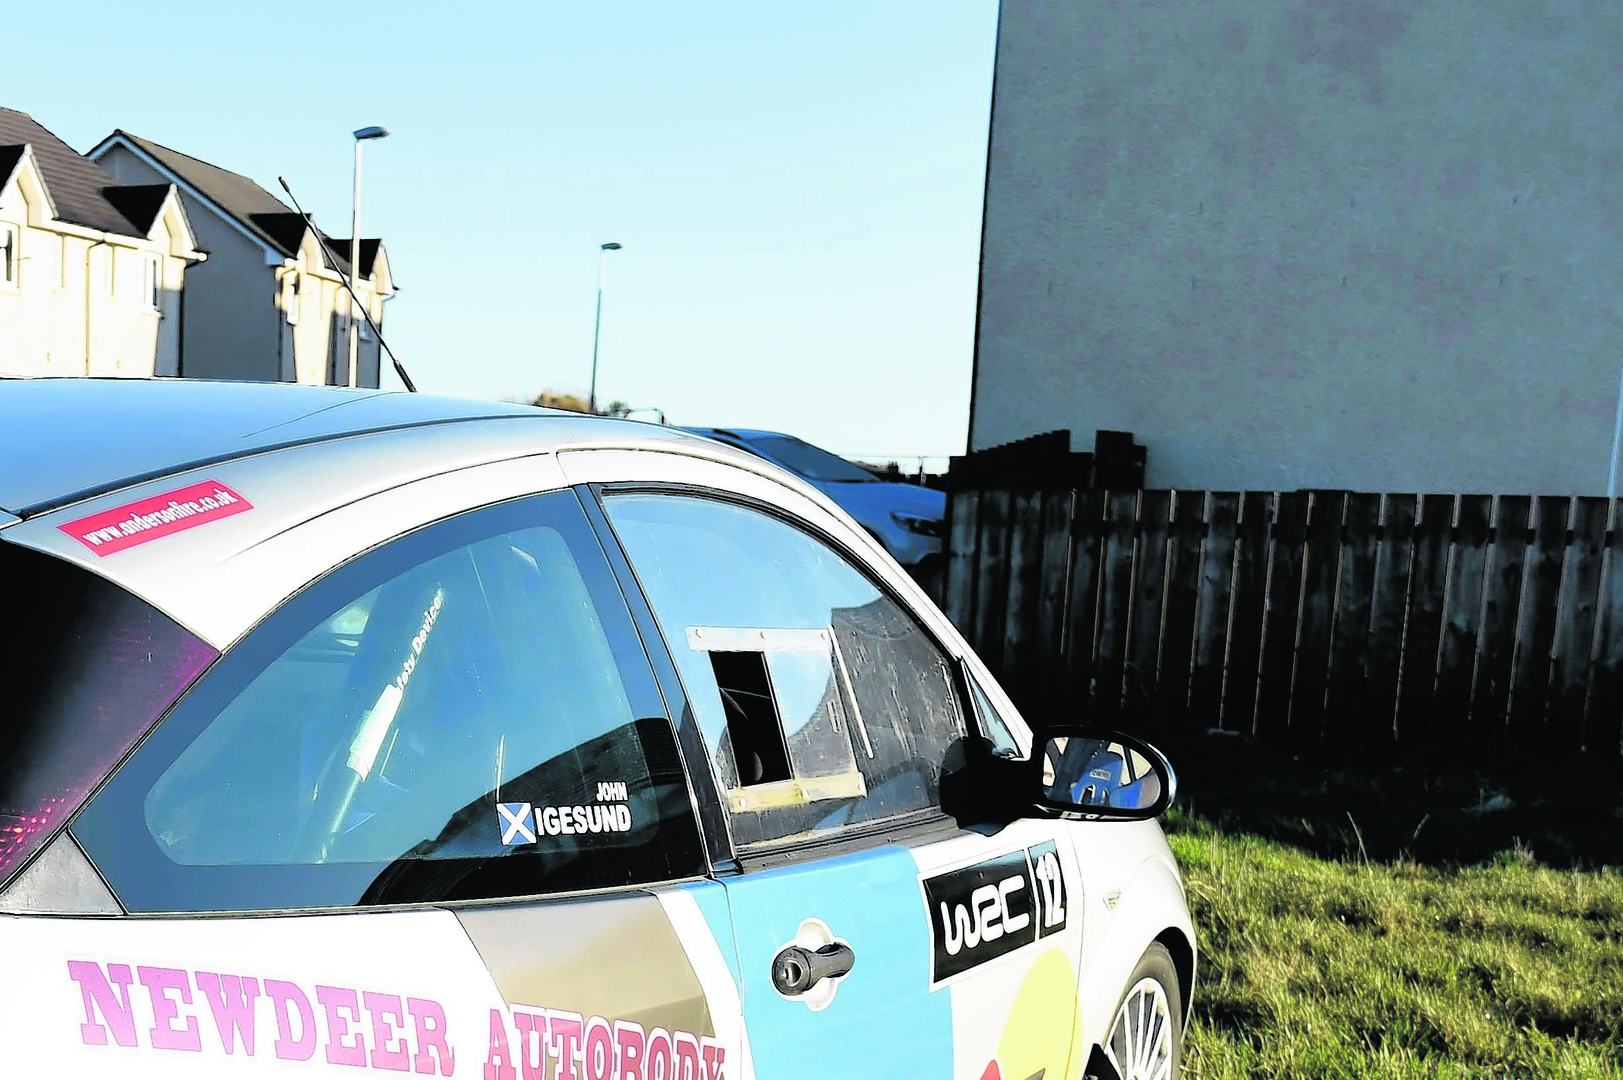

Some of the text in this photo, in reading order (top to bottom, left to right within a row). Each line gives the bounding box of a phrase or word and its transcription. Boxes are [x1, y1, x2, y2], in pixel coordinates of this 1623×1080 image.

[596, 781, 628, 802] JOHN
[534, 804, 632, 836] IGESUND
[1036, 851, 1065, 928] 12
[67, 960, 455, 1077] NEWDEER
